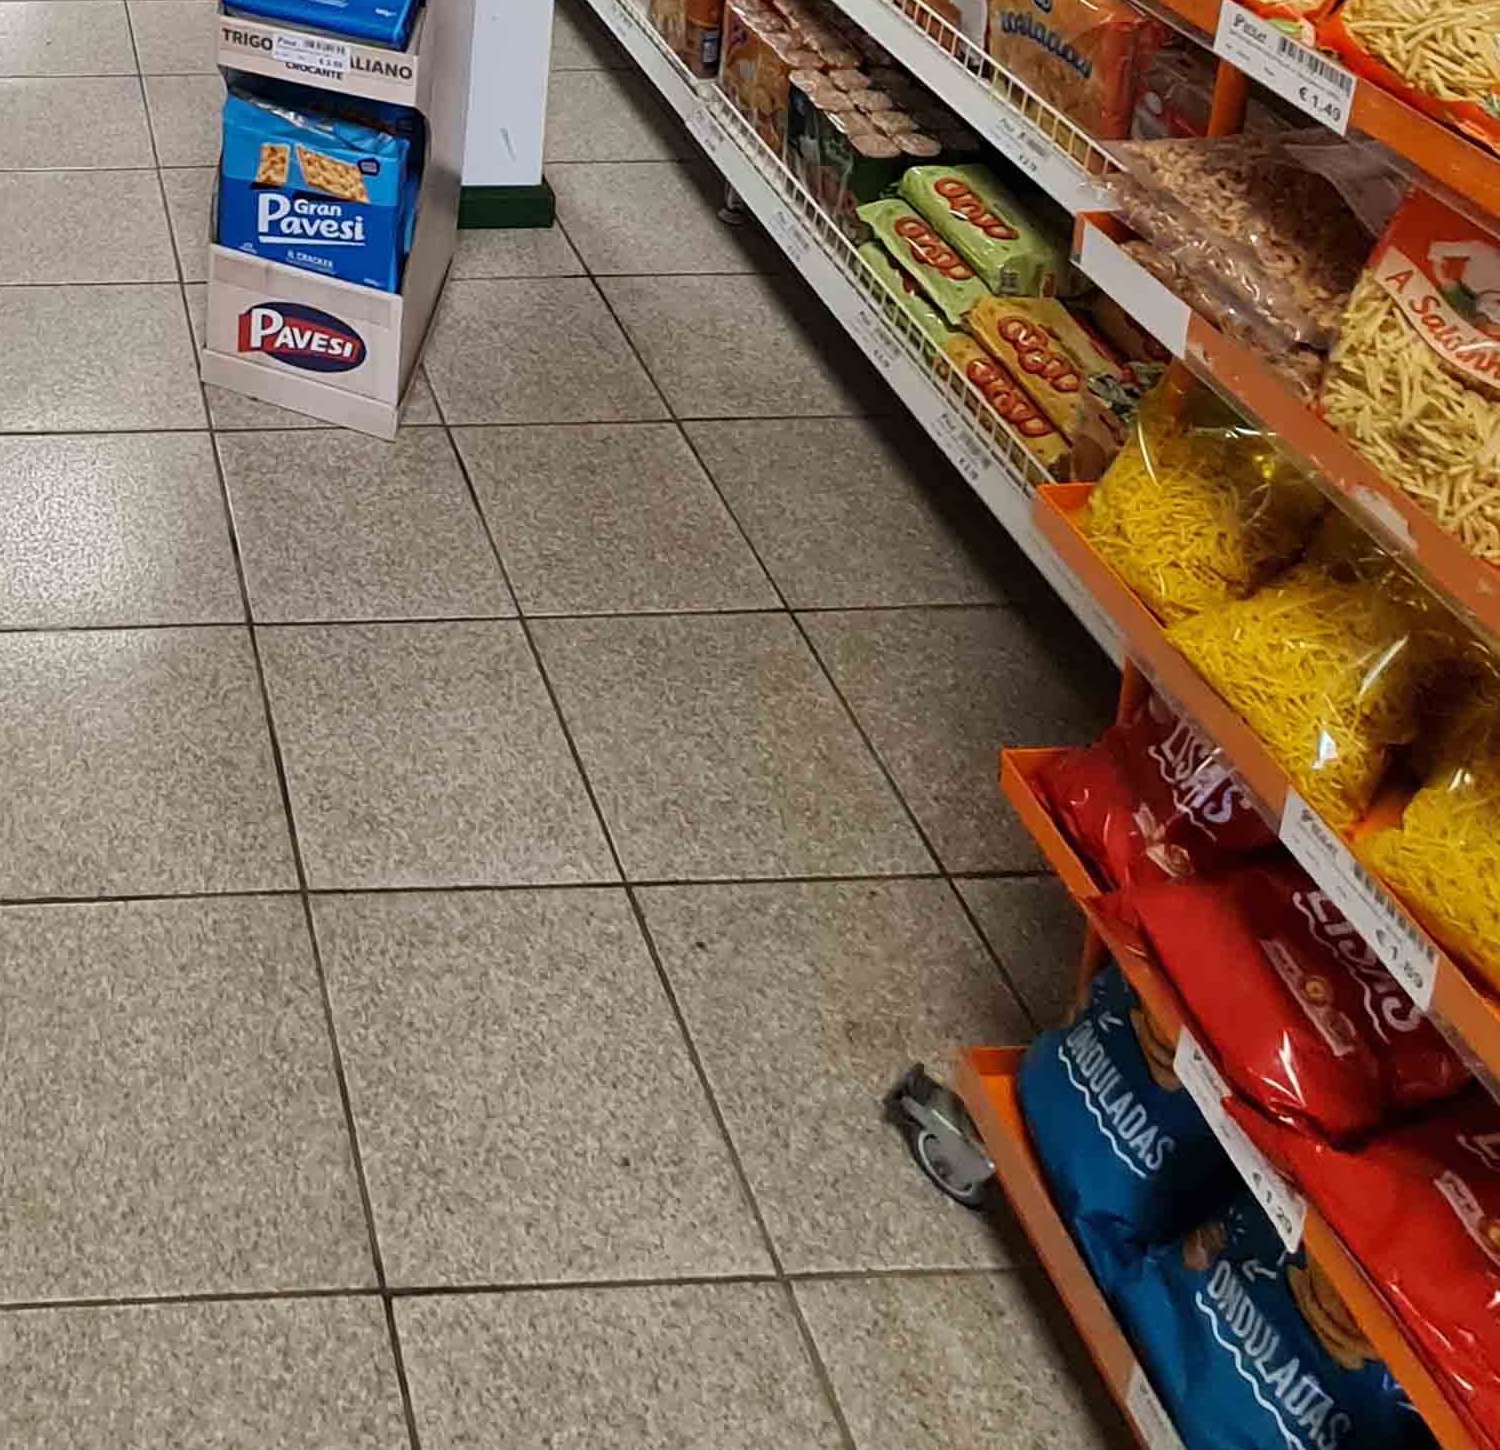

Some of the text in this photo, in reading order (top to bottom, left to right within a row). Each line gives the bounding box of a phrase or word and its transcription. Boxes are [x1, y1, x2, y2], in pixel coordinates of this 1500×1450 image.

[222, 28, 413, 80] TRIGO LIANO
[284, 61, 344, 81] CROCANTE
[257, 192, 366, 242] Pavesi
[293, 198, 343, 217] Gran
[1385, 267, 1414, 296] A
[249, 307, 354, 359] PAVESI
[1066, 1020, 1177, 1172] ONDULADAS
[1206, 1260, 1350, 1450] ONDULADAS
